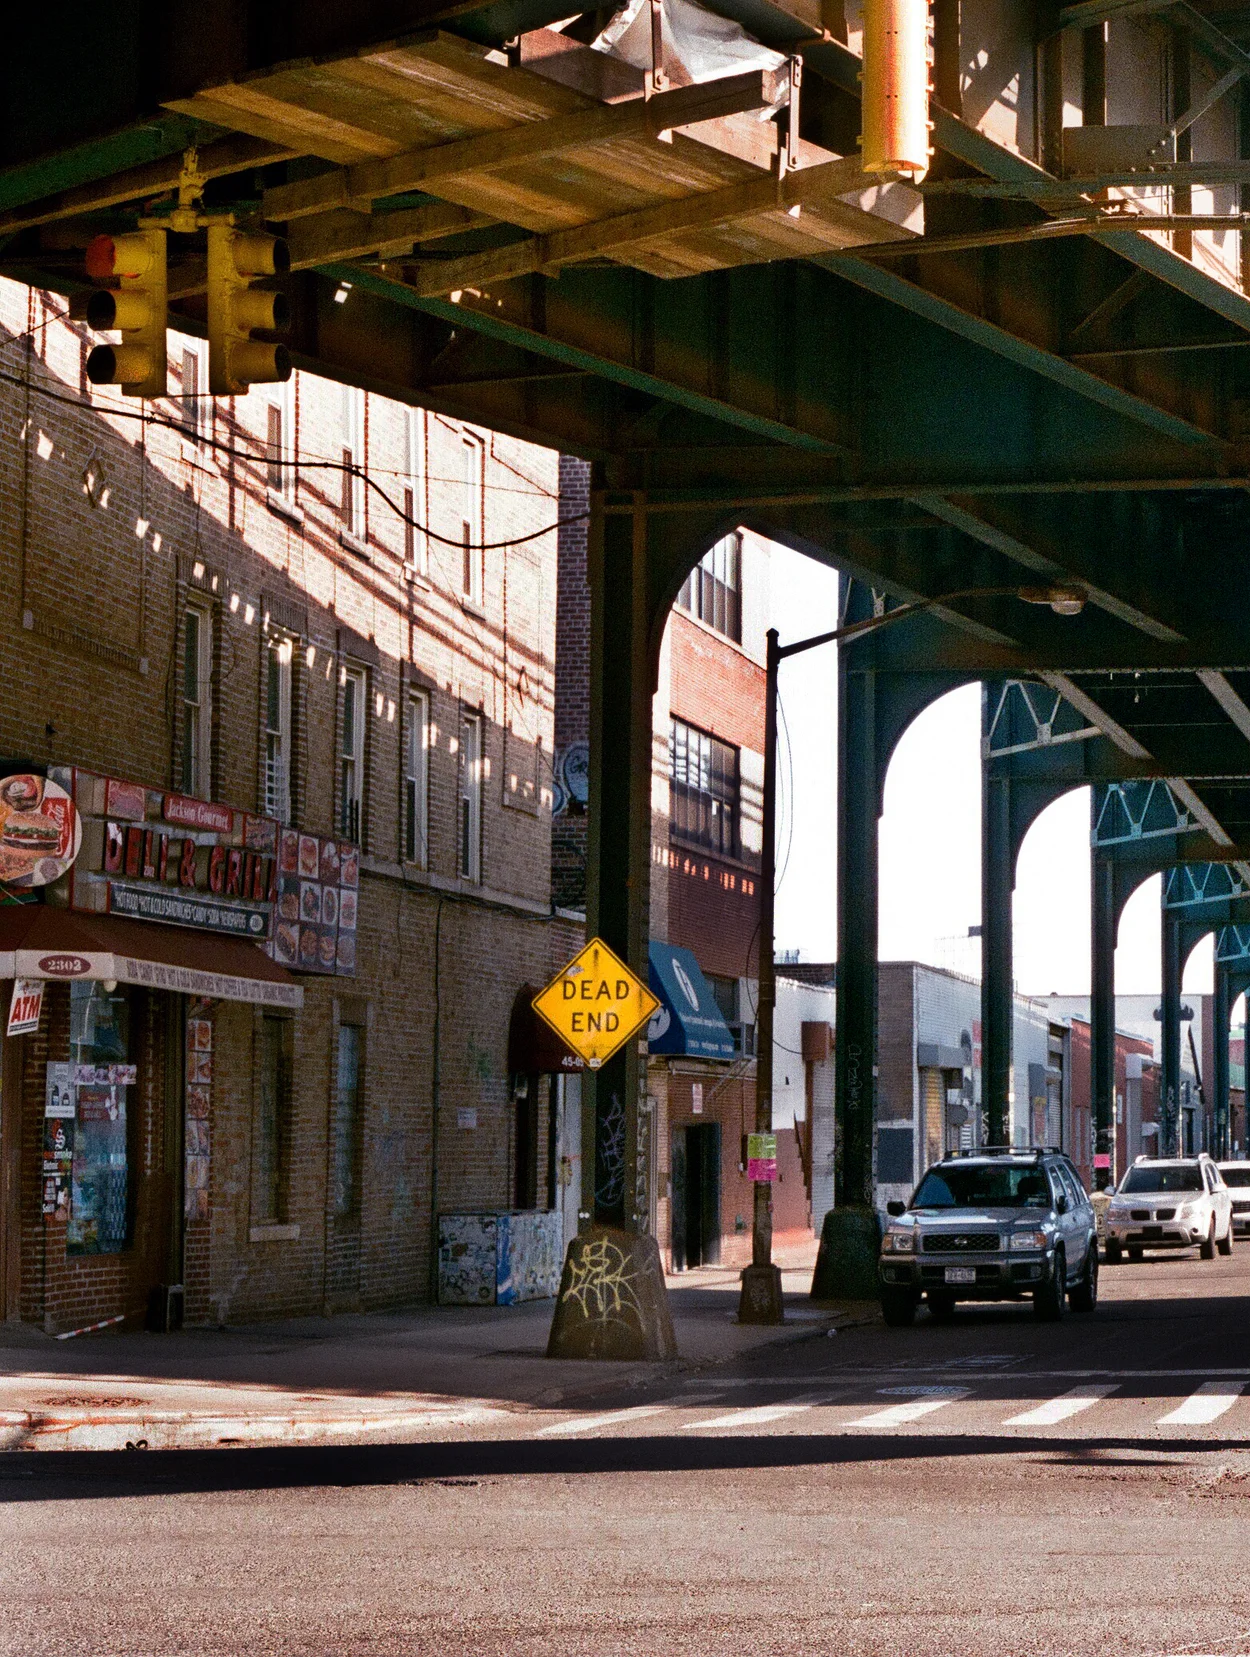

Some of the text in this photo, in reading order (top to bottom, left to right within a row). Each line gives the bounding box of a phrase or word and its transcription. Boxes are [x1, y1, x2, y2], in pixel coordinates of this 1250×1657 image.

[168, 799, 229, 830] Jackson Gourmet
[104, 822, 278, 902] DELI & GRILL
[48, 959, 82, 971] 2302
[562, 979, 631, 1000] DEAD
[11, 993, 41, 1023] ATM
[571, 1012, 620, 1033] END
